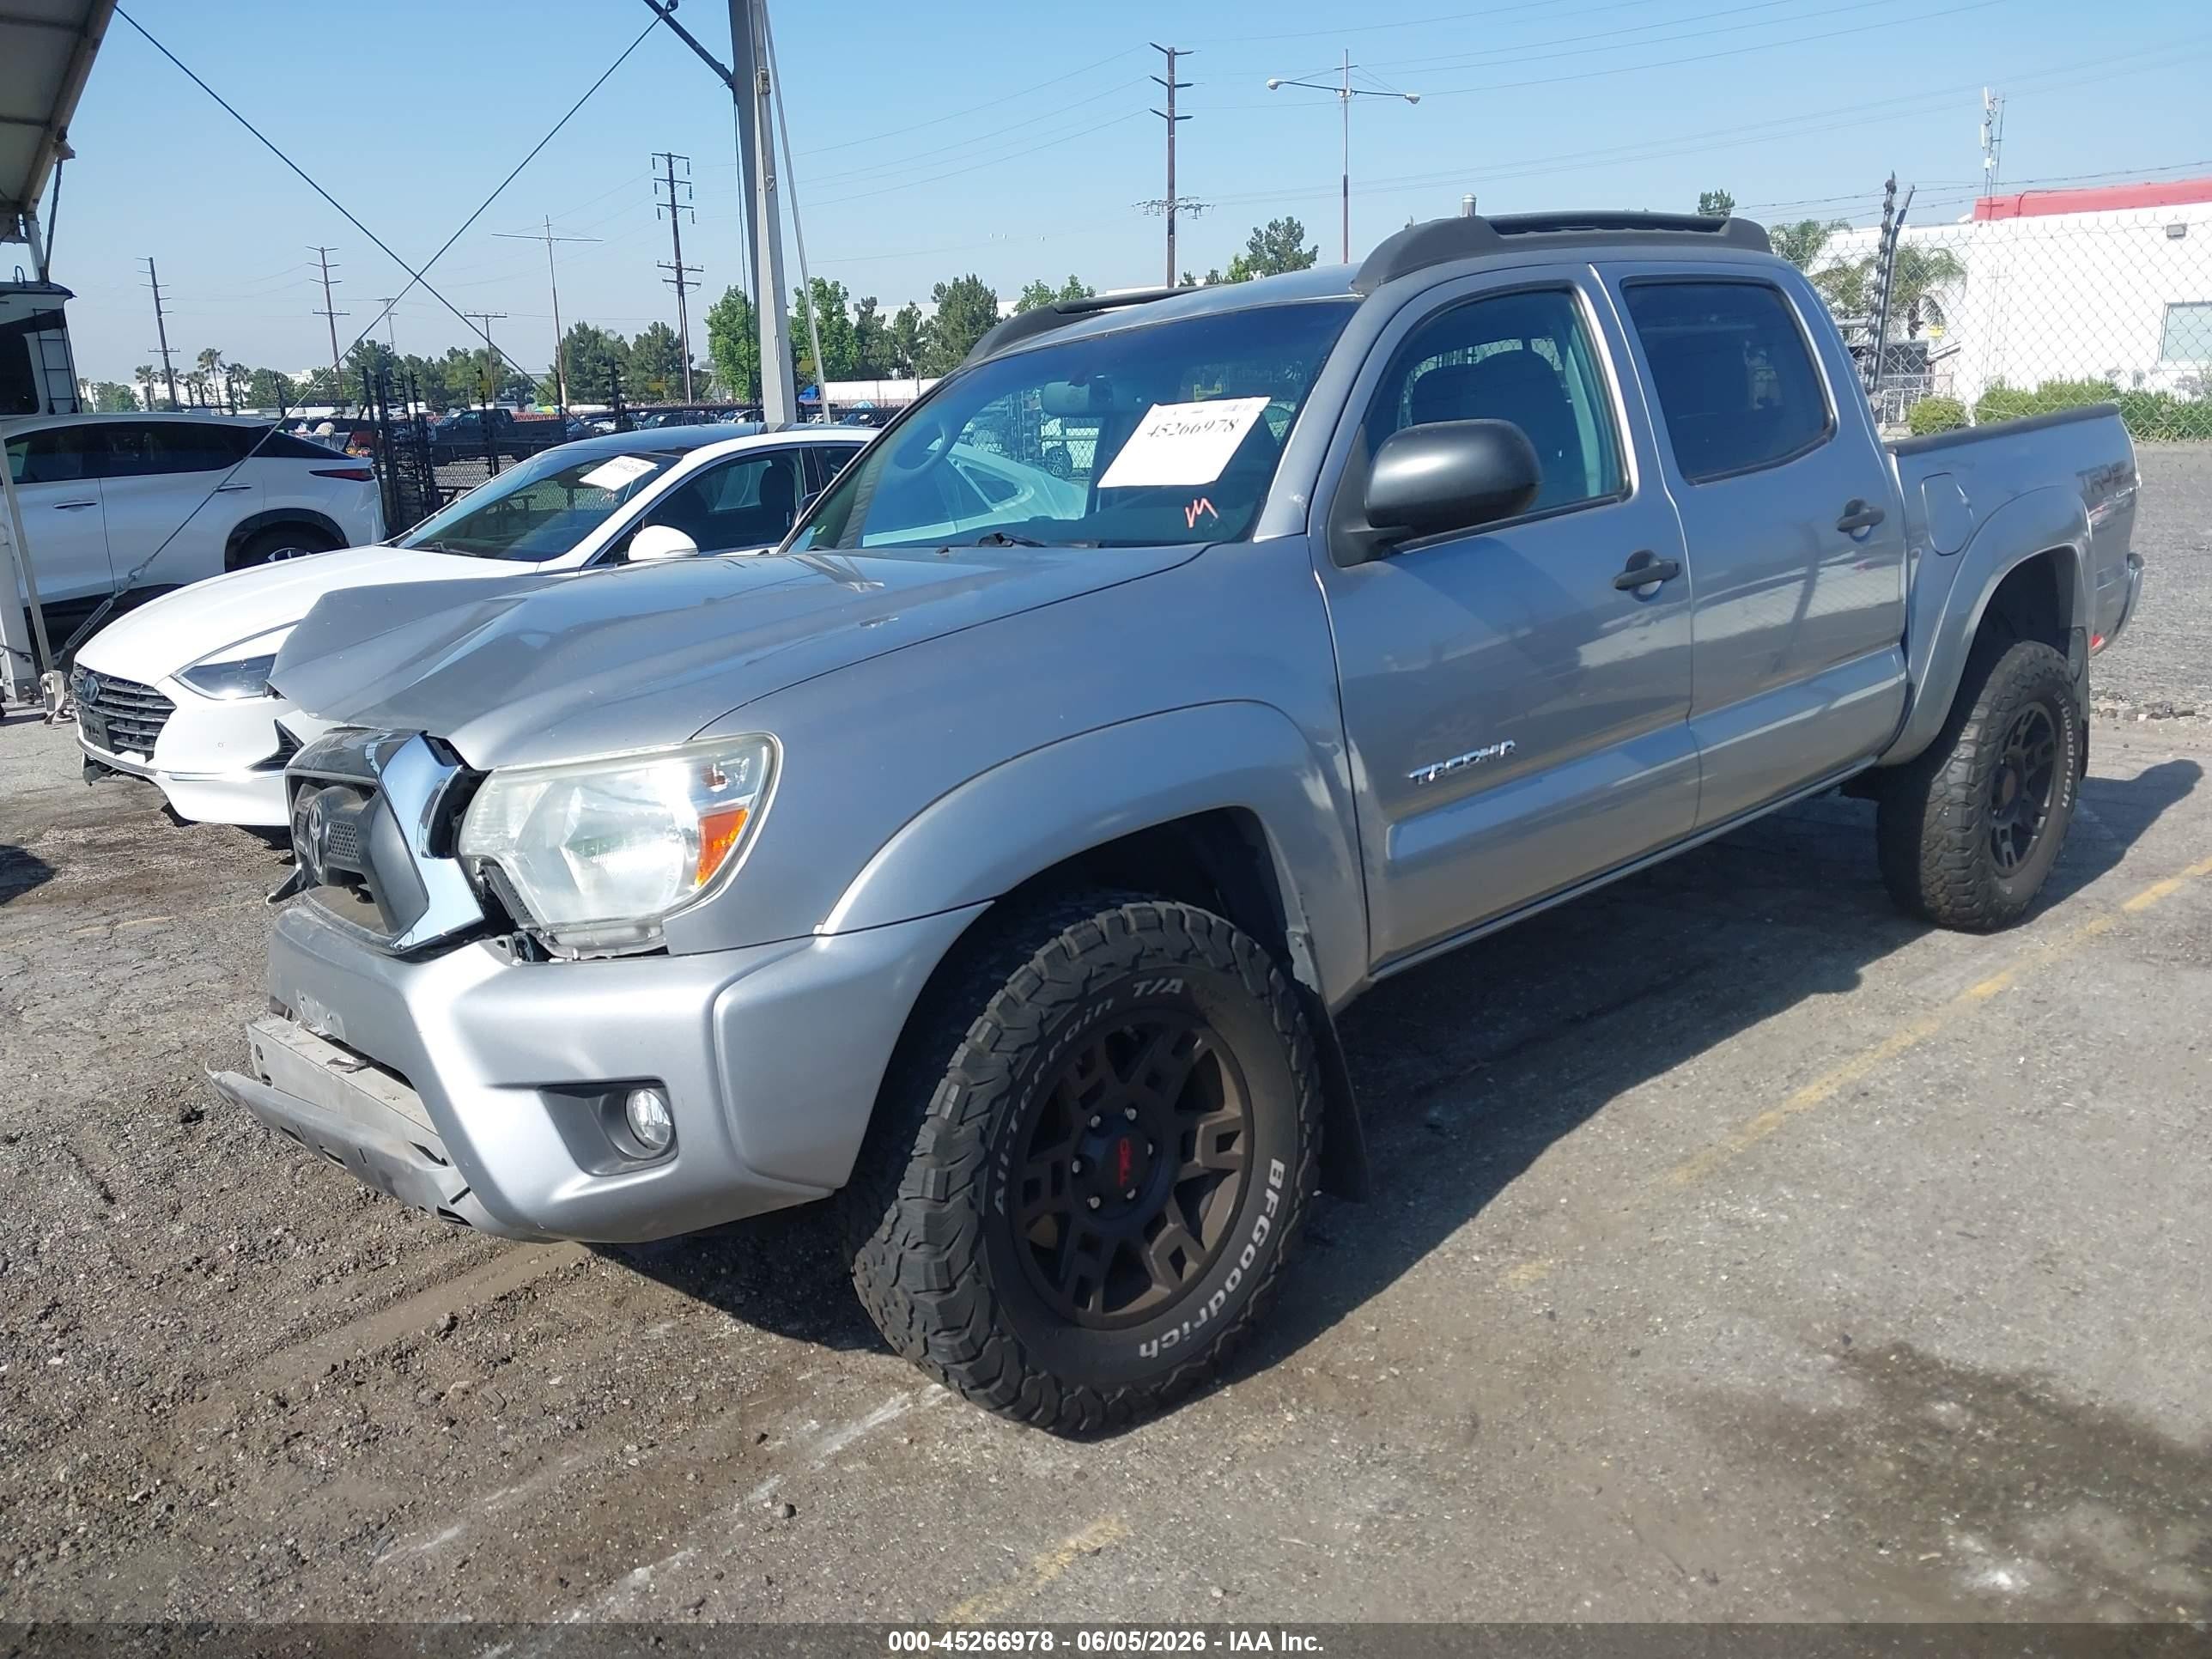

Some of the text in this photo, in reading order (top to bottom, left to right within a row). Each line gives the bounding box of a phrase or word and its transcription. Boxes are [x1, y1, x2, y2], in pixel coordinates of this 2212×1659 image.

[1147, 417, 1240, 438] 45266978
[1133, 976, 1184, 996] T/A
[1139, 1158, 1286, 1359] BFGoodrich
